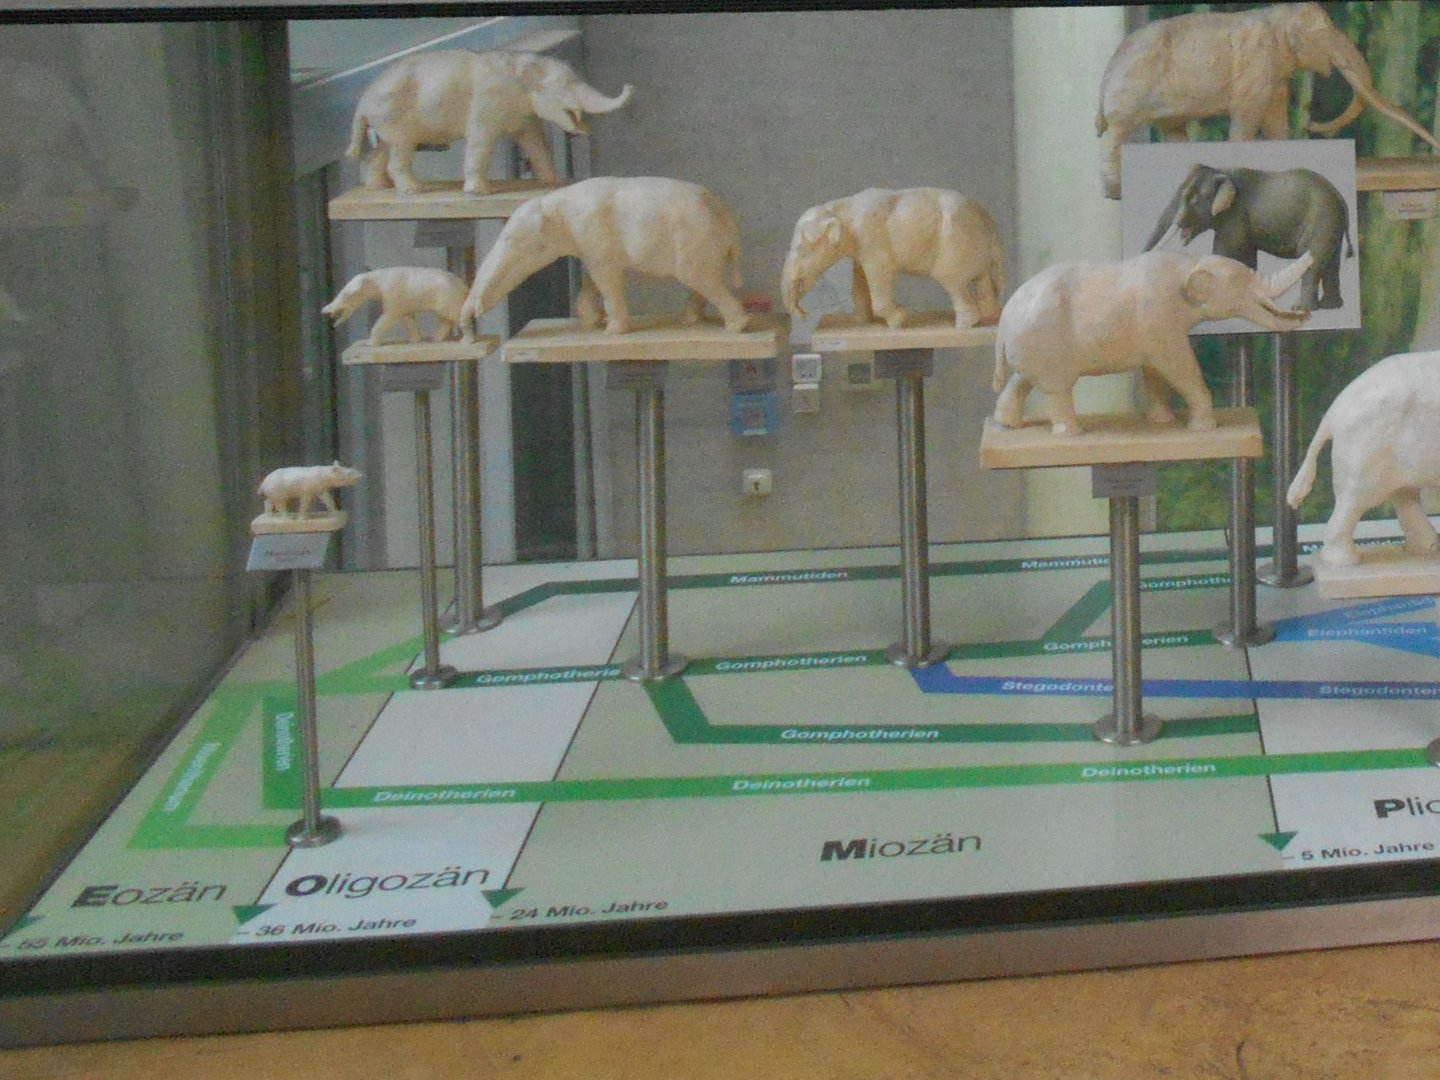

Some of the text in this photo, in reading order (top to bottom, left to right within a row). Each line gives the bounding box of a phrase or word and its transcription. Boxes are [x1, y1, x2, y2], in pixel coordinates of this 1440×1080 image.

[1021, 557, 1111, 569] Mammuti
[729, 569, 849, 583] Mammutiden
[1306, 626, 1428, 638] Elephantiden
[1043, 634, 1189, 652] Gompherien
[715, 653, 868, 672] Gomphotherien
[476, 666, 621, 686] Gomphotherie
[1001, 681, 1113, 693] Stegodonte
[780, 727, 940, 743] Gomphotherien
[1081, 762, 1217, 778] Deinotherien
[731, 774, 872, 792] Deinotherien
[371, 786, 517, 804] Deinotherien
[819, 832, 984, 862] Miozän
[1301, 850, 1314, 861] 5
[1320, 846, 1369, 860] Mio.
[1374, 839, 1435, 854] Jahre
[284, 866, 491, 899] Oligozän
[70, 881, 228, 908] Eozän
[511, 908, 540, 921] 24
[547, 904, 597, 918] Mio.
[602, 898, 669, 914] Jahre
[255, 923, 285, 937] 36
[292, 920, 343, 935] Mio.
[348, 916, 416, 932] Jahre
[54, 934, 103, 947] Mio.
[113, 928, 185, 944] Jahre
